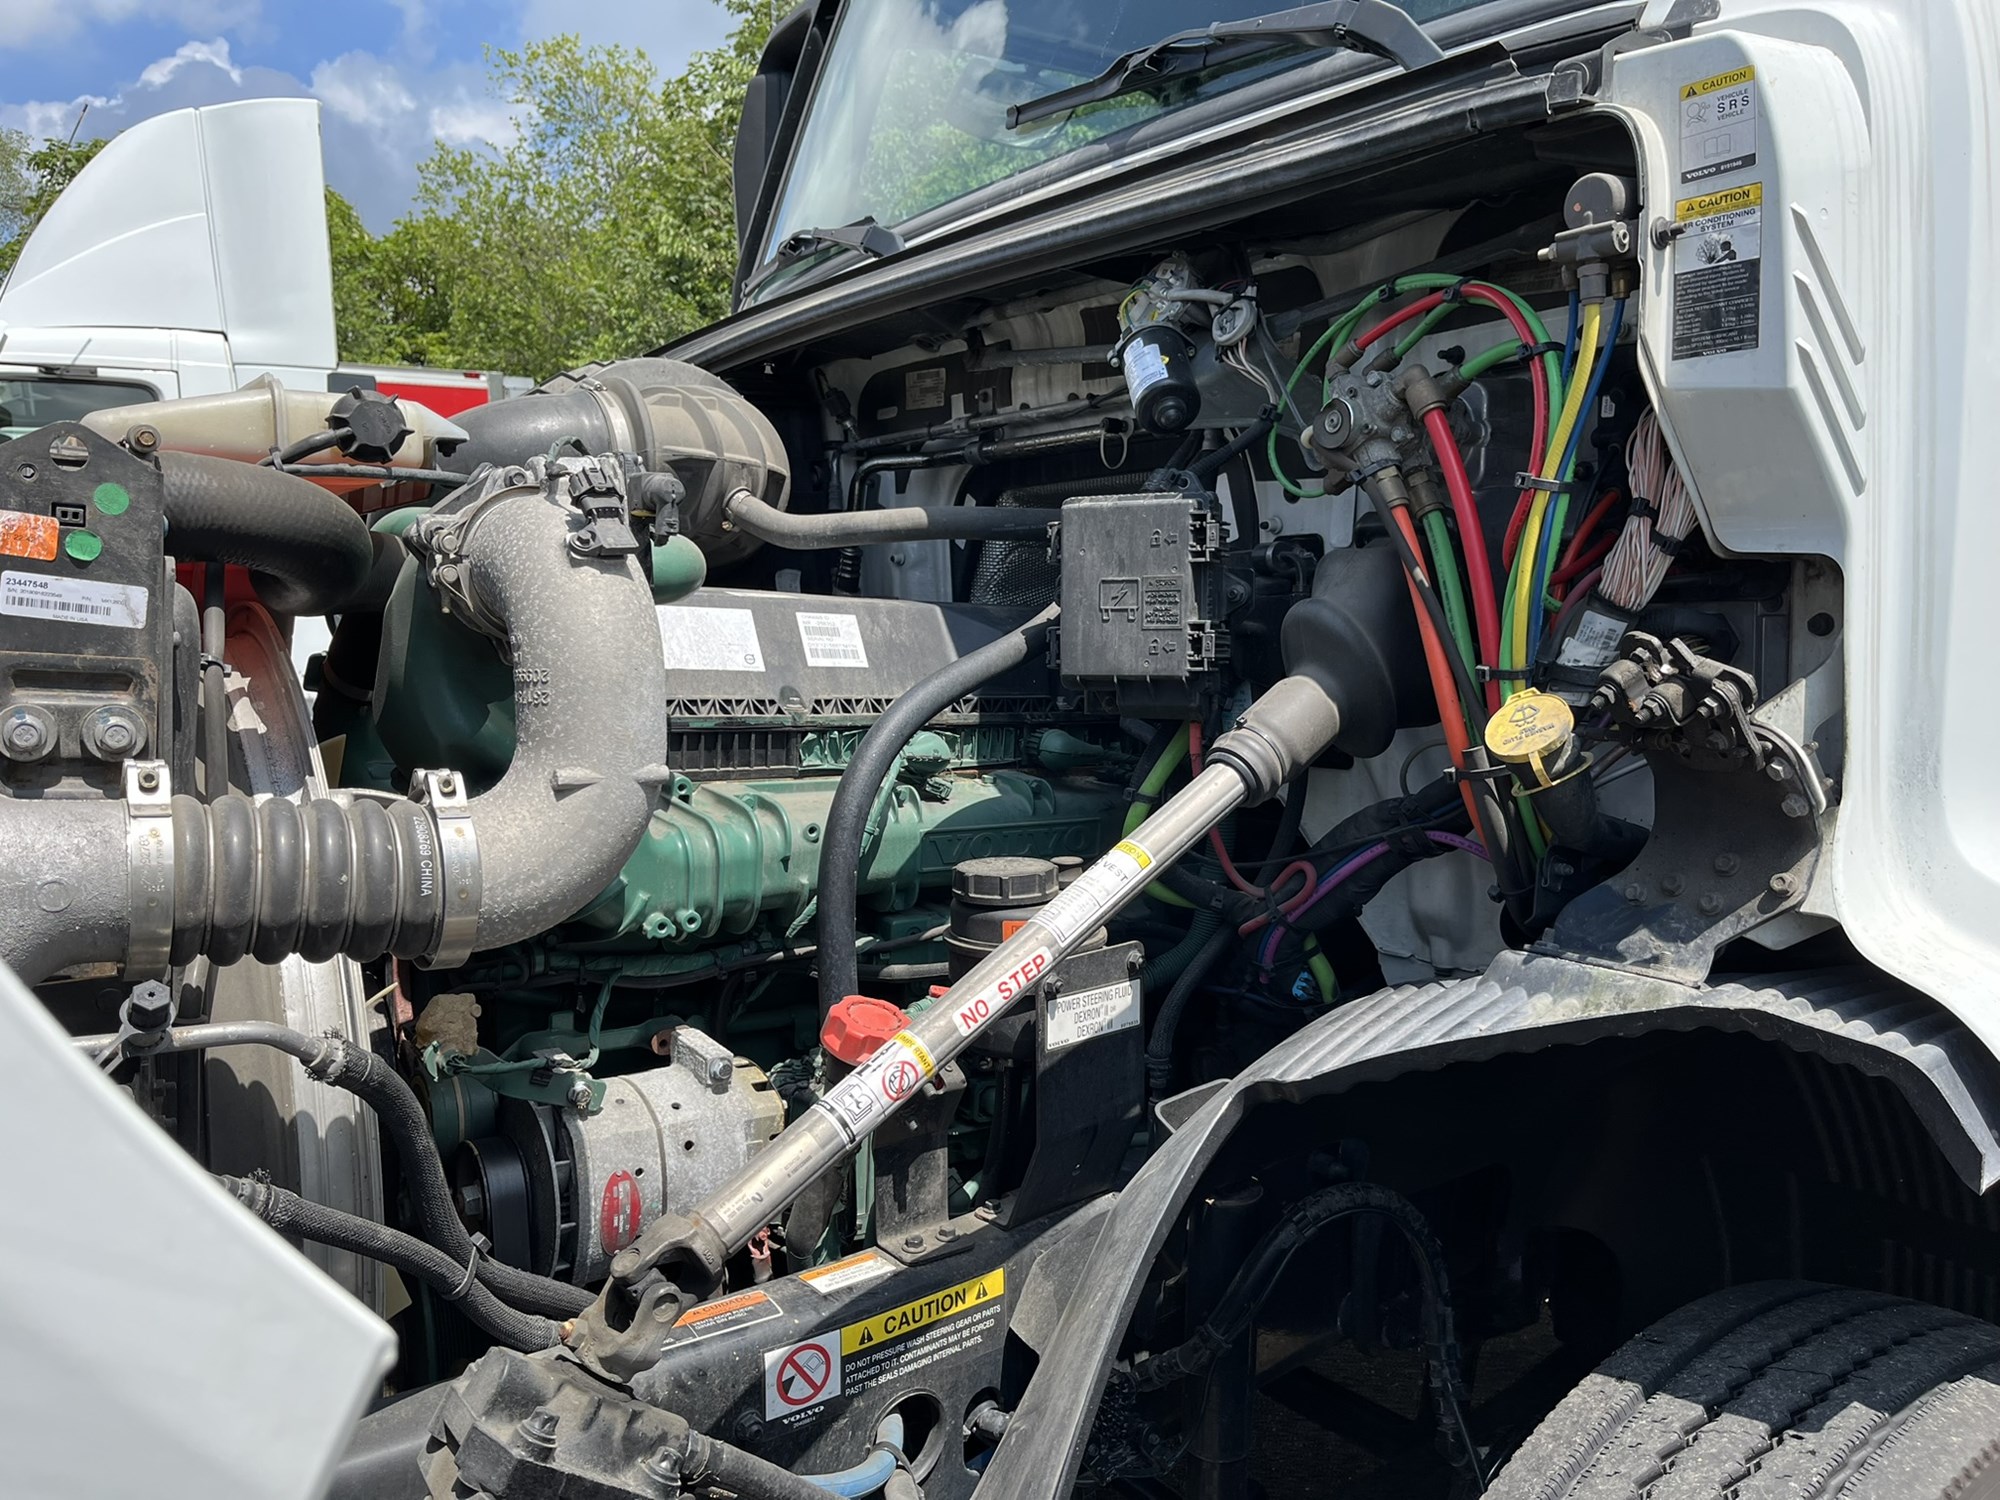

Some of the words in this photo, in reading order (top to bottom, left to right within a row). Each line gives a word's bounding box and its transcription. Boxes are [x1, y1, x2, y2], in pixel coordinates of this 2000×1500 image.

[1702, 70, 1747, 91] CAUTION
[1716, 88, 1748, 102] VEHICULE
[1716, 109, 1744, 121] VEHICLE
[1686, 167, 1716, 179] VOLVO
[1698, 189, 1750, 209] CAUTION
[1695, 208, 1756, 227] CONDITIONING
[1700, 220, 1734, 233] SYSTEM
[6, 577, 49, 589] 23447548
[413, 815, 432, 856] 22908769
[929, 825, 1092, 866] VOLVO
[420, 859, 433, 897] CHINA
[960, 999, 989, 1030] NO
[997, 954, 1045, 1000] STEP
[1057, 997, 1081, 1014] POWER
[1082, 989, 1113, 1007] STEERING
[1114, 984, 1132, 999] FLUID
[824, 1257, 865, 1272] WARNING
[702, 1294, 752, 1312] CUIDADO
[884, 1288, 967, 1334] CAUTION
[845, 1362, 856, 1372] DO
[857, 1357, 871, 1368] NOT
[871, 1342, 906, 1364] PRESSURE
[906, 1335, 925, 1349] WASH
[925, 1323, 955, 1341] STEERING
[955, 1317, 972, 1329] GEAR
[972, 1313, 982, 1322] OR
[982, 1304, 1001, 1318] PARTS
[845, 1366, 880, 1384] ATTACHED
[881, 1362, 890, 1371] TO
[891, 1359, 900, 1368] IT.
[900, 1339, 947, 1364] CONTAMINANTS
[948, 1333, 961, 1344] MAY
[962, 1329, 971, 1338] BE
[971, 1319, 995, 1334] FORCED
[845, 1384, 863, 1396] PAST
[864, 1376, 877, 1388] THE
[877, 1369, 899, 1384] SEALS
[899, 1355, 933, 1375] DAMAGING
[933, 1344, 962, 1361] INTERNAL
[962, 1335, 983, 1349] PARTS.
[782, 1405, 825, 1424] VOLVO
